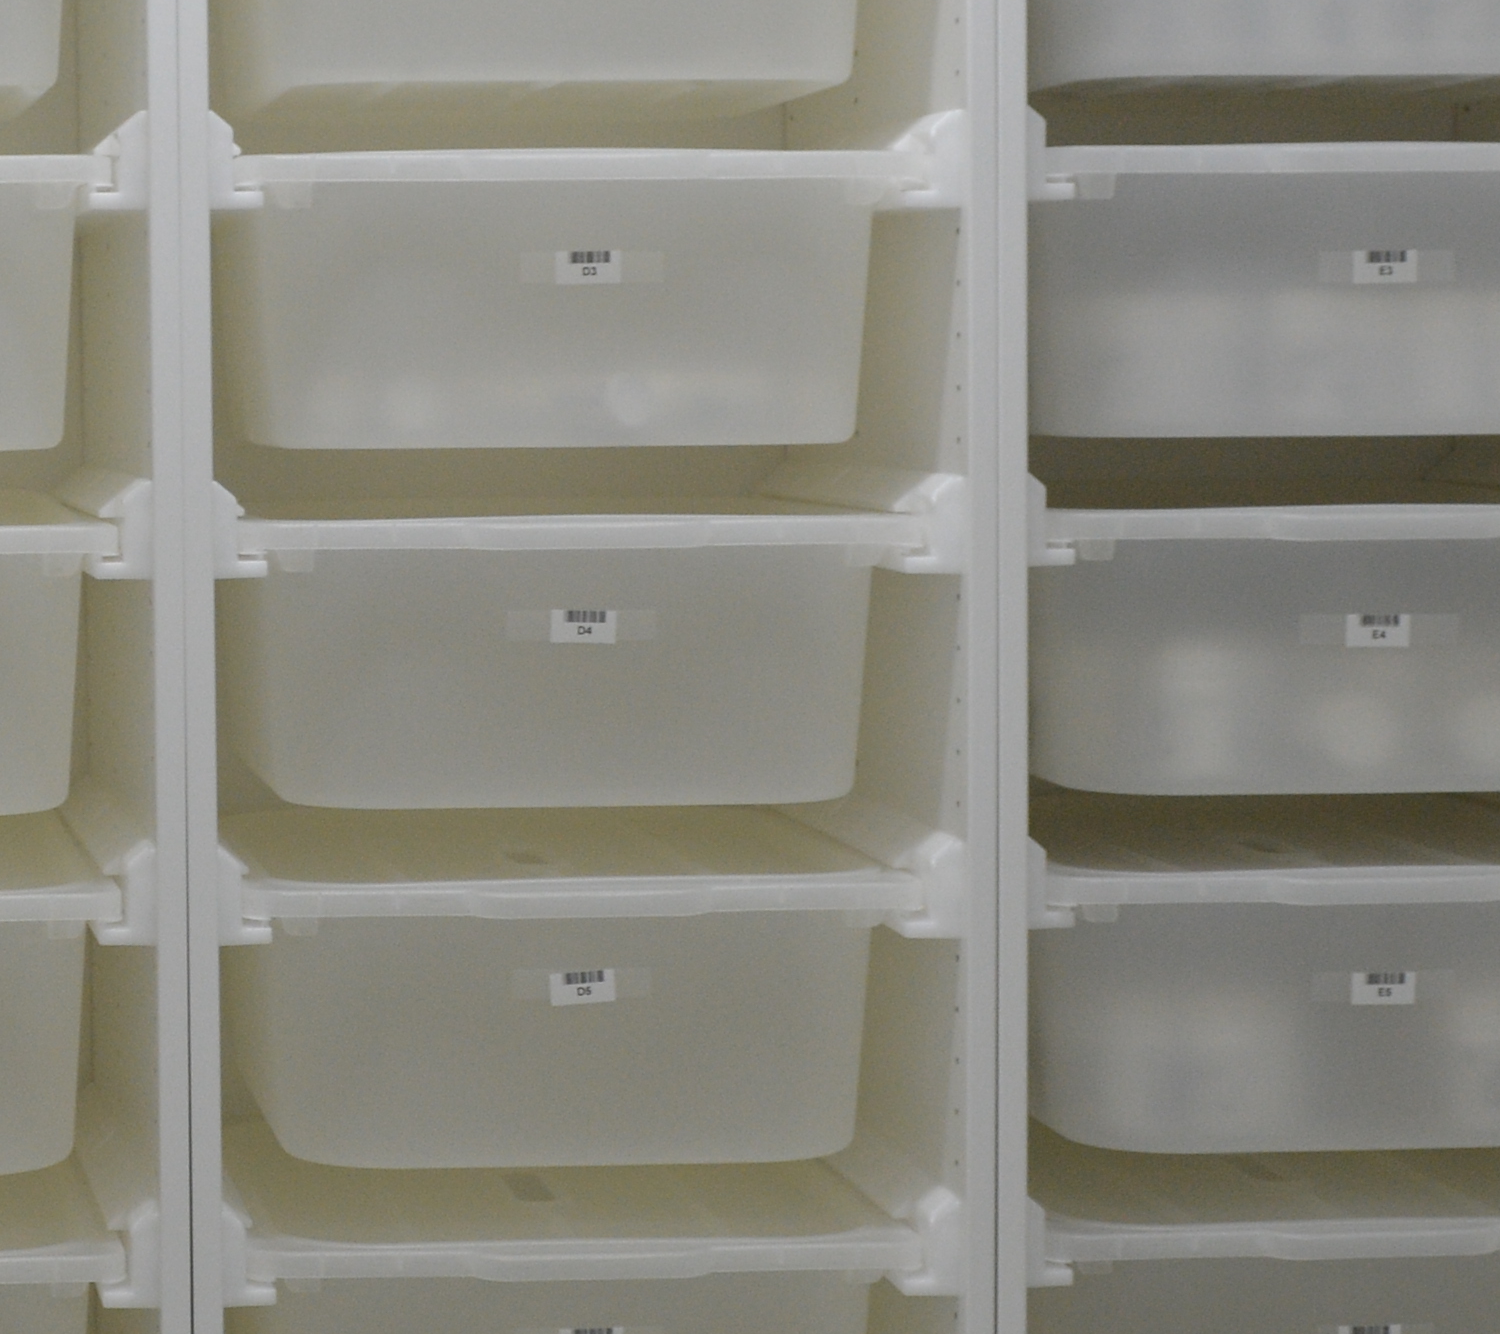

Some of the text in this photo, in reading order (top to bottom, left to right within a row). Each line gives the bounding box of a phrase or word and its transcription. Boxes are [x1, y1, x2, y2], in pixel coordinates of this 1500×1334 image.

[581, 265, 598, 277] D3
[576, 624, 593, 636] D4
[1371, 629, 1387, 640] E4
[575, 985, 593, 997] D5
